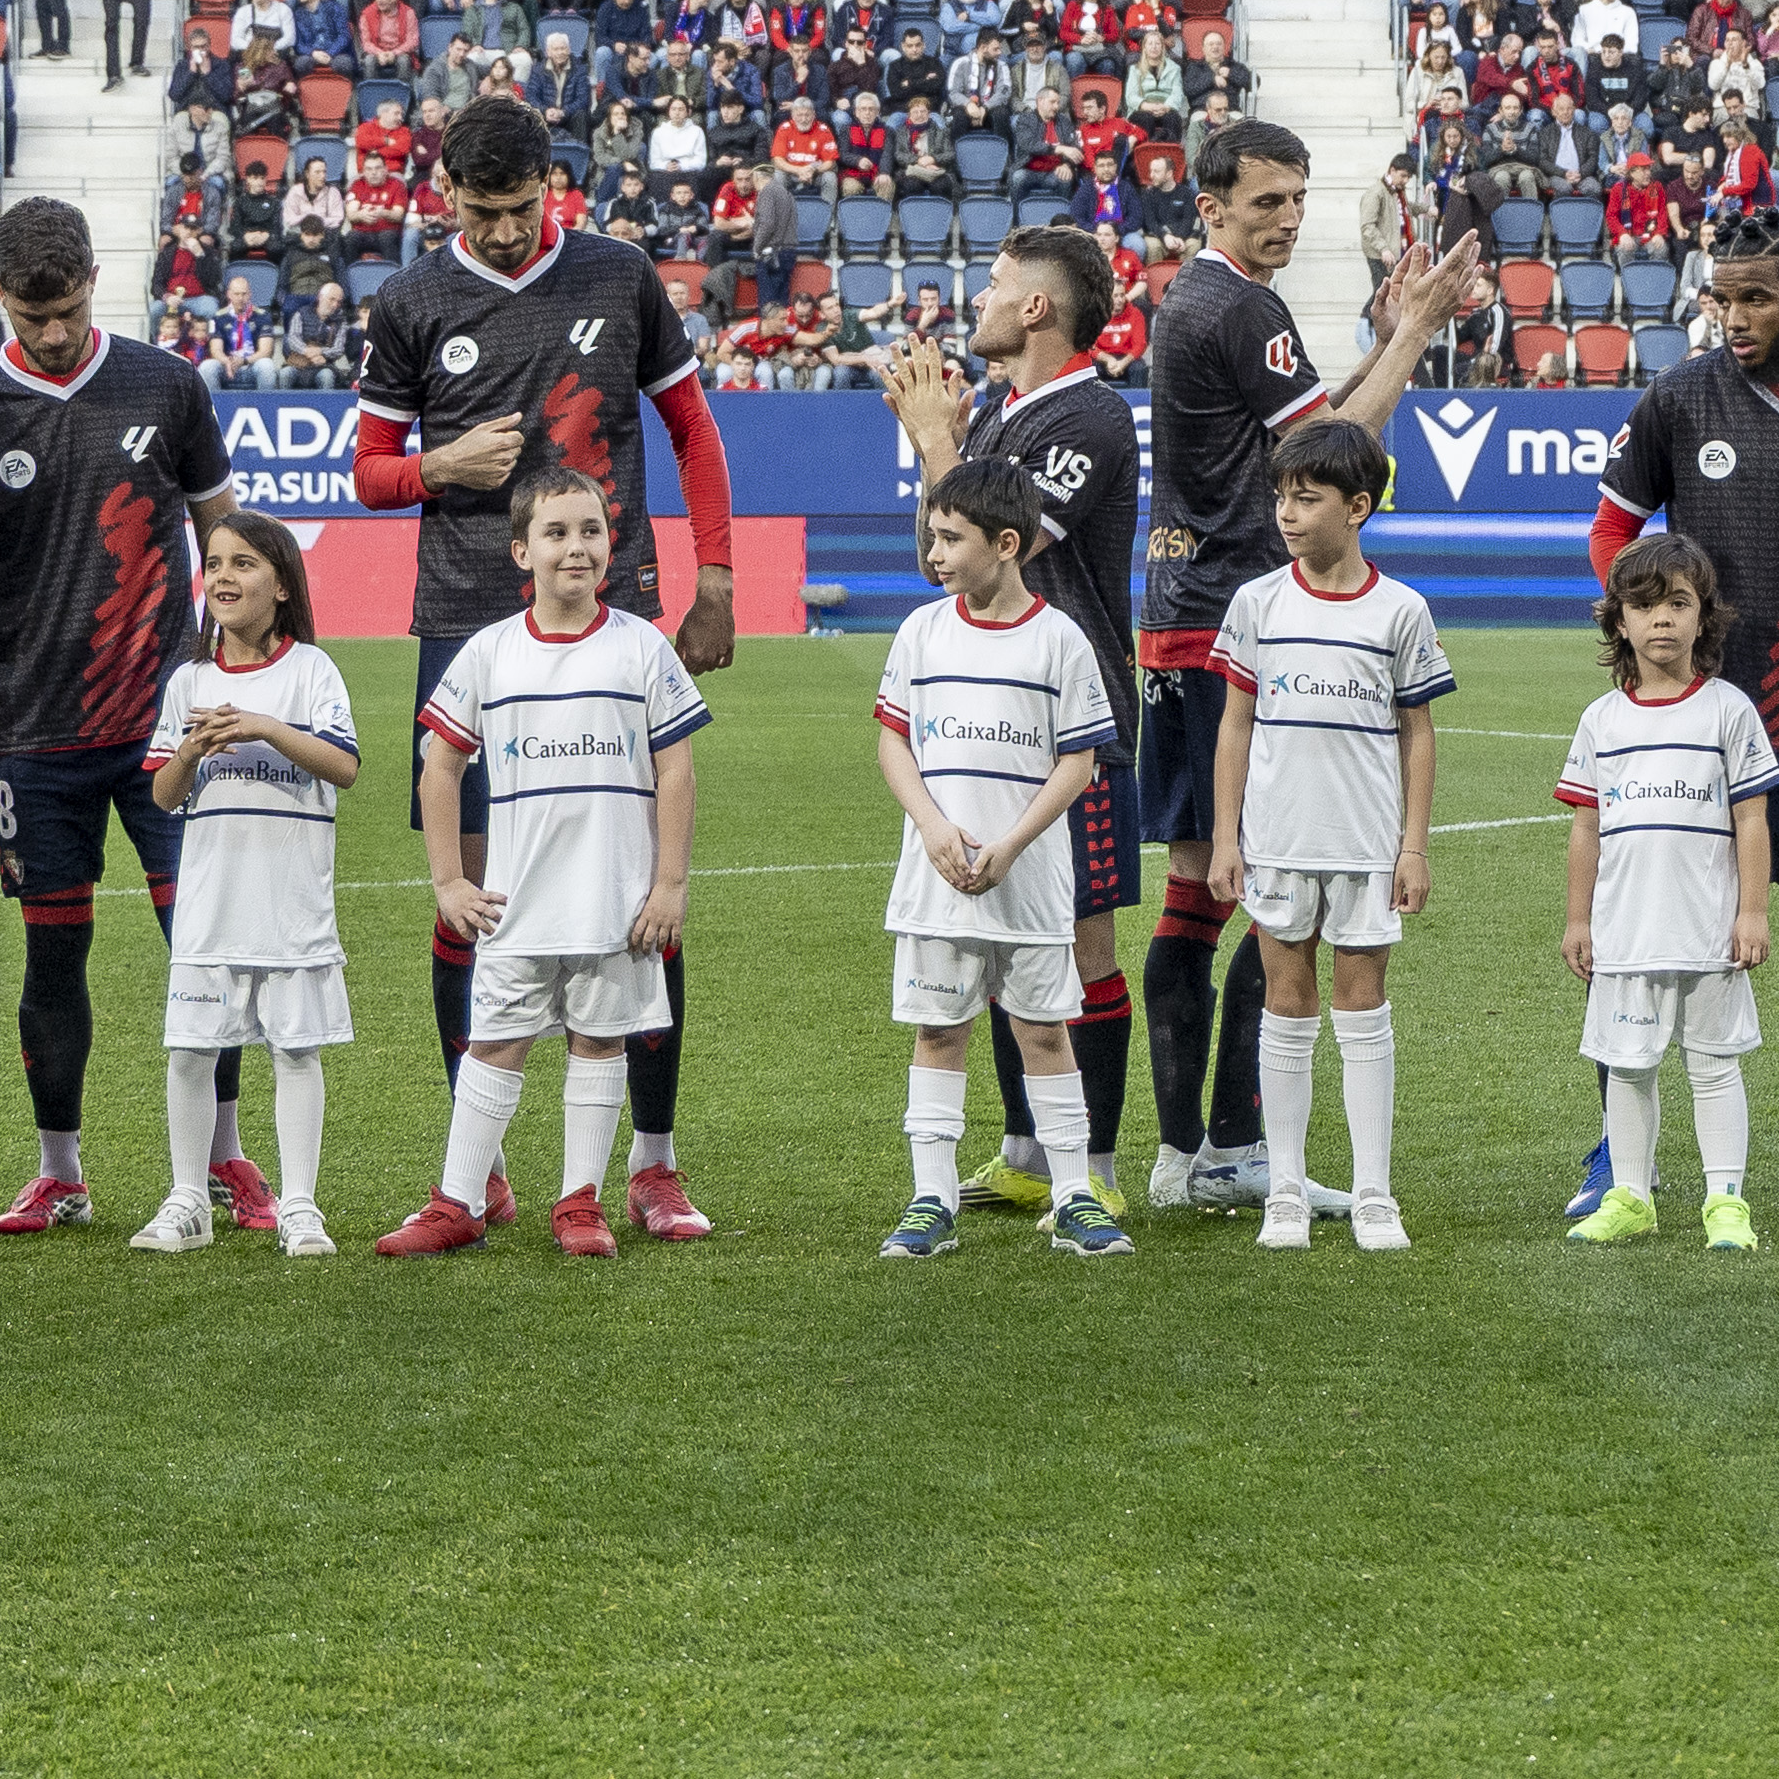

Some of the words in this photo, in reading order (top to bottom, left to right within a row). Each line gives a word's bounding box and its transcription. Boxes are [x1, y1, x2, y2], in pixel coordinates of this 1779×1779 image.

[448, 345, 471, 359] EA
[5, 458, 29, 473] EA
[1045, 445, 1092, 489] VS
[1705, 449, 1728, 461] EA
[233, 471, 358, 503] SASUN
[1031, 471, 1074, 504] RACISM
[1294, 674, 1383, 703] CaixaBank
[941, 715, 1044, 749] CaixaBank
[522, 733, 626, 760] CaixaBank
[208, 760, 301, 783] CaixaBank
[1624, 779, 1714, 803] CaixaBank
[180, 992, 222, 1003] CaixaBank
